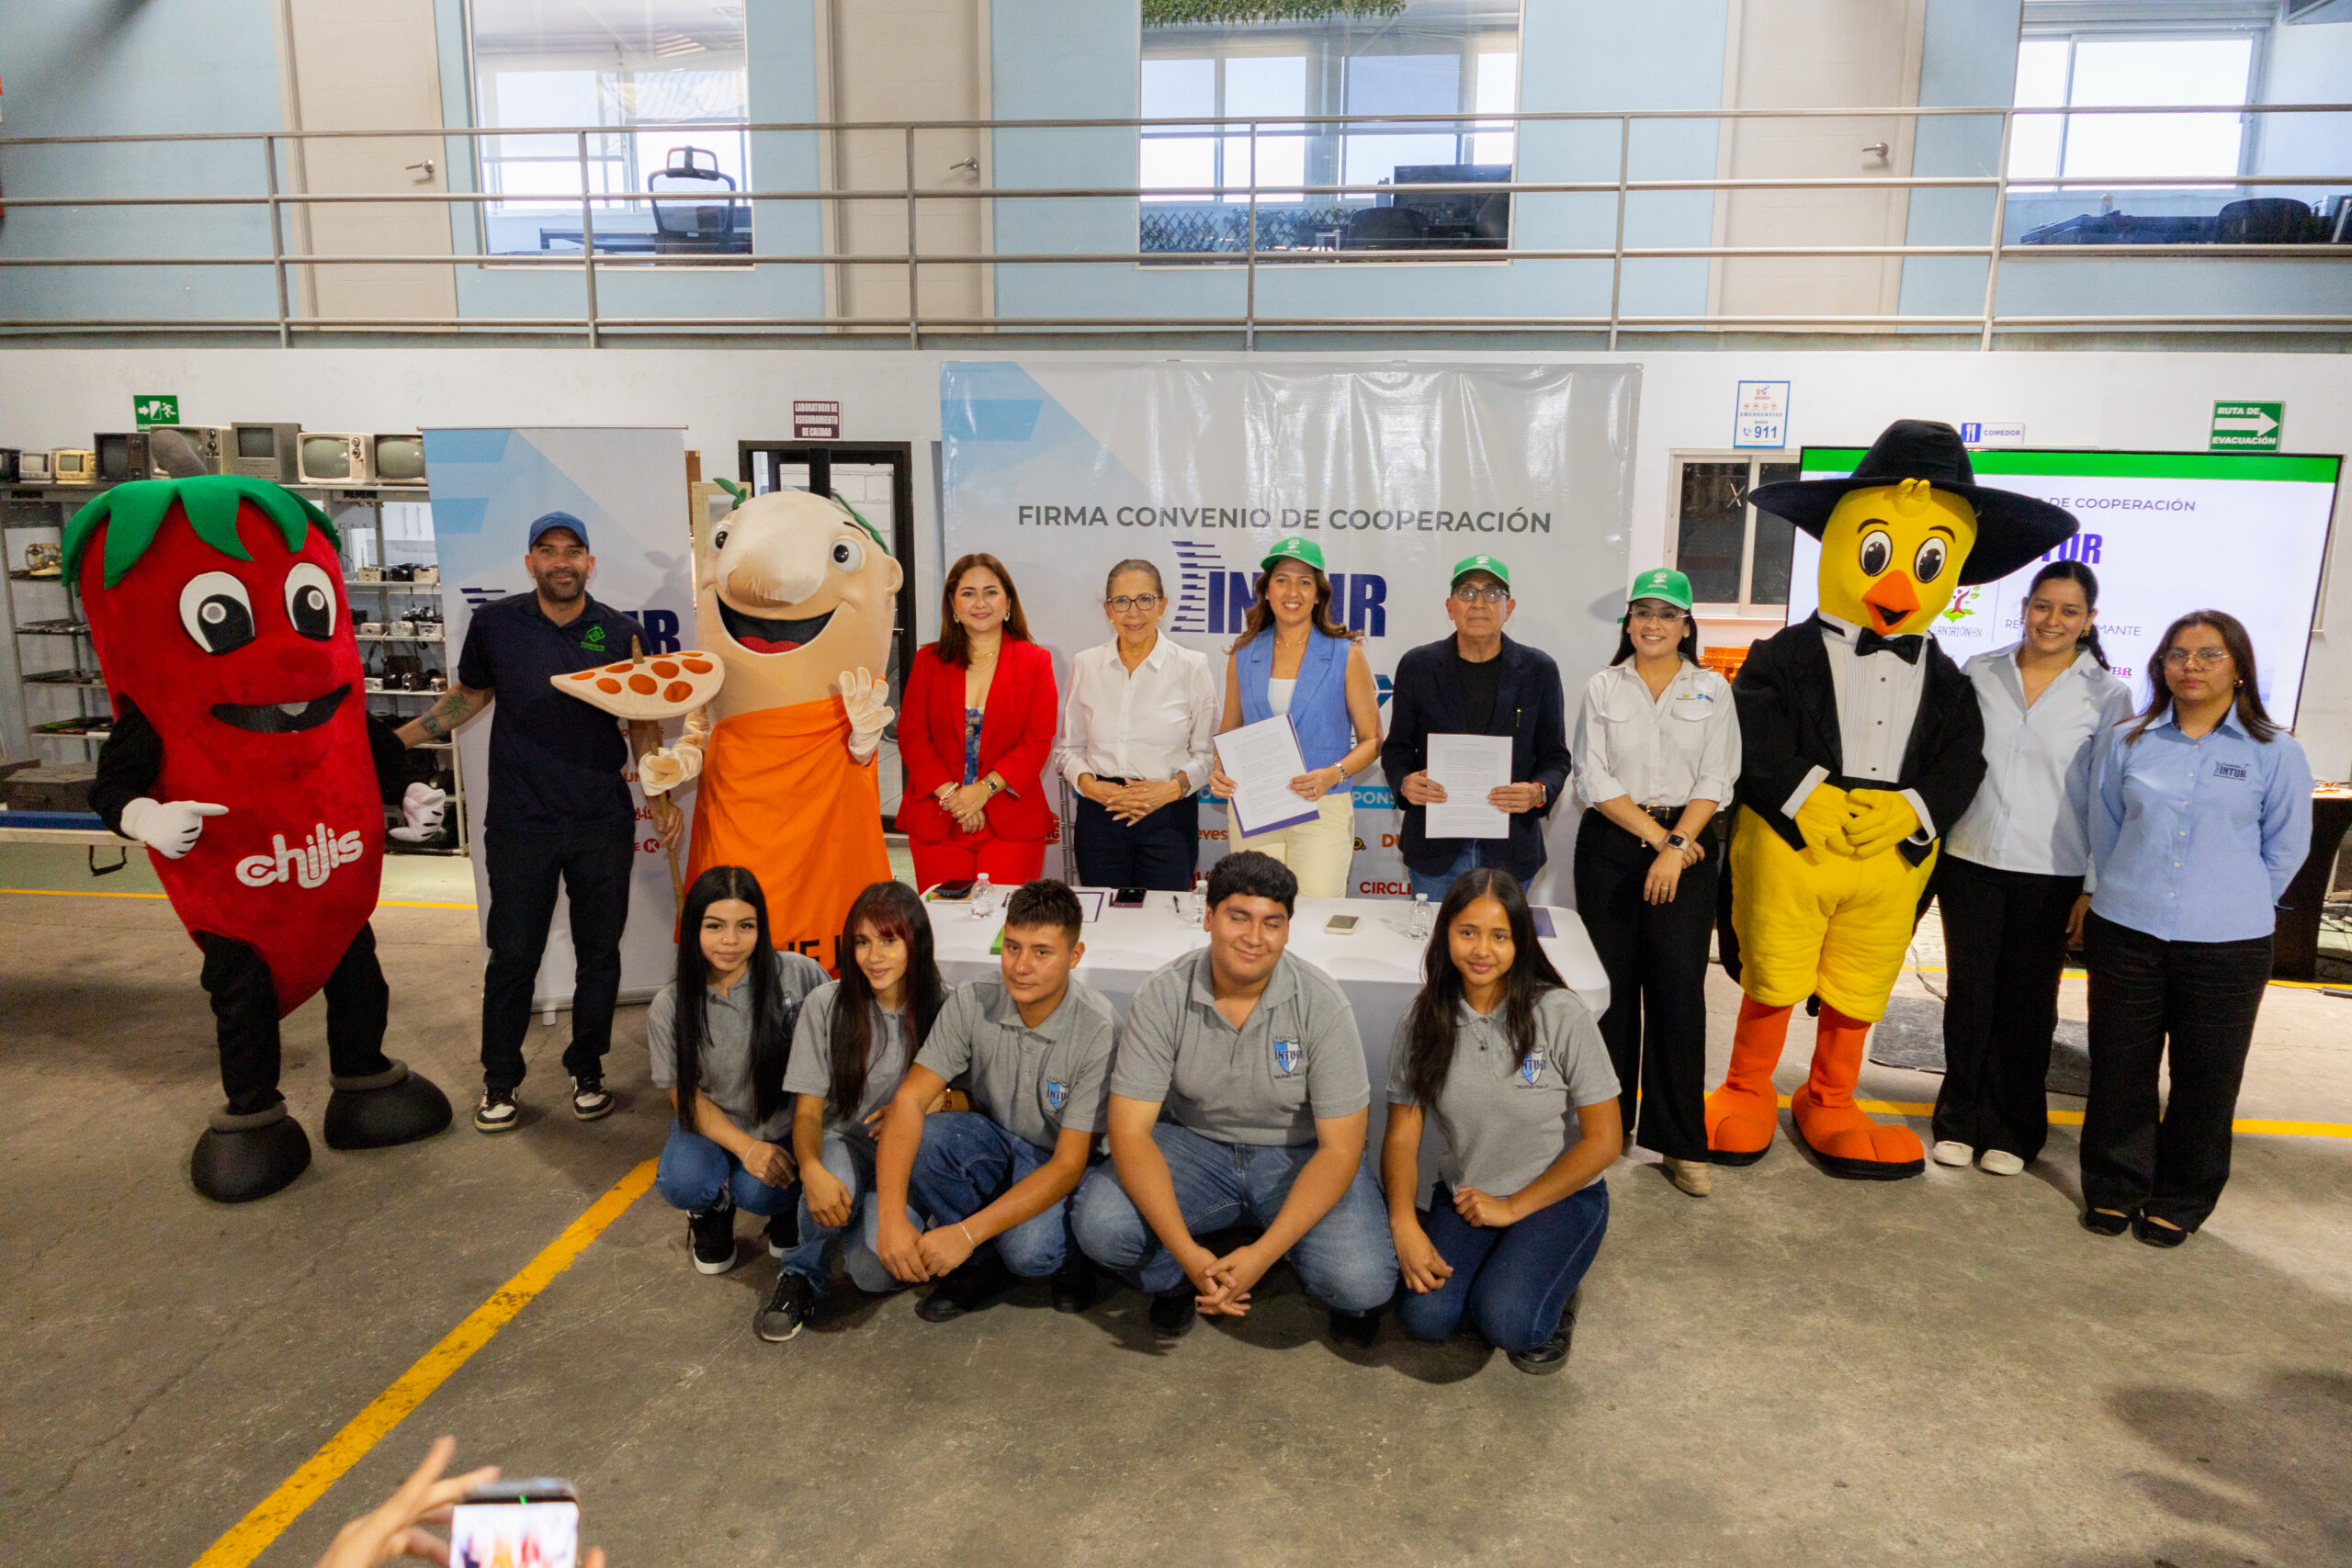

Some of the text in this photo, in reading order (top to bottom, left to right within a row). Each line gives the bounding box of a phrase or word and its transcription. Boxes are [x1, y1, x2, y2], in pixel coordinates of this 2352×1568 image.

[831, 403, 839, 412] DE
[2217, 407, 2261, 415] RUTA DE
[1754, 425, 1777, 439] 911
[2211, 434, 2278, 445] EVACUACIÓN
[2075, 498, 2197, 512] COOPERACIÓN
[1018, 505, 1552, 534] FIRMA CONVENIO DE COOPERACIÓN
[2097, 624, 2142, 637] MANTE
[235, 823, 364, 889] chilis
